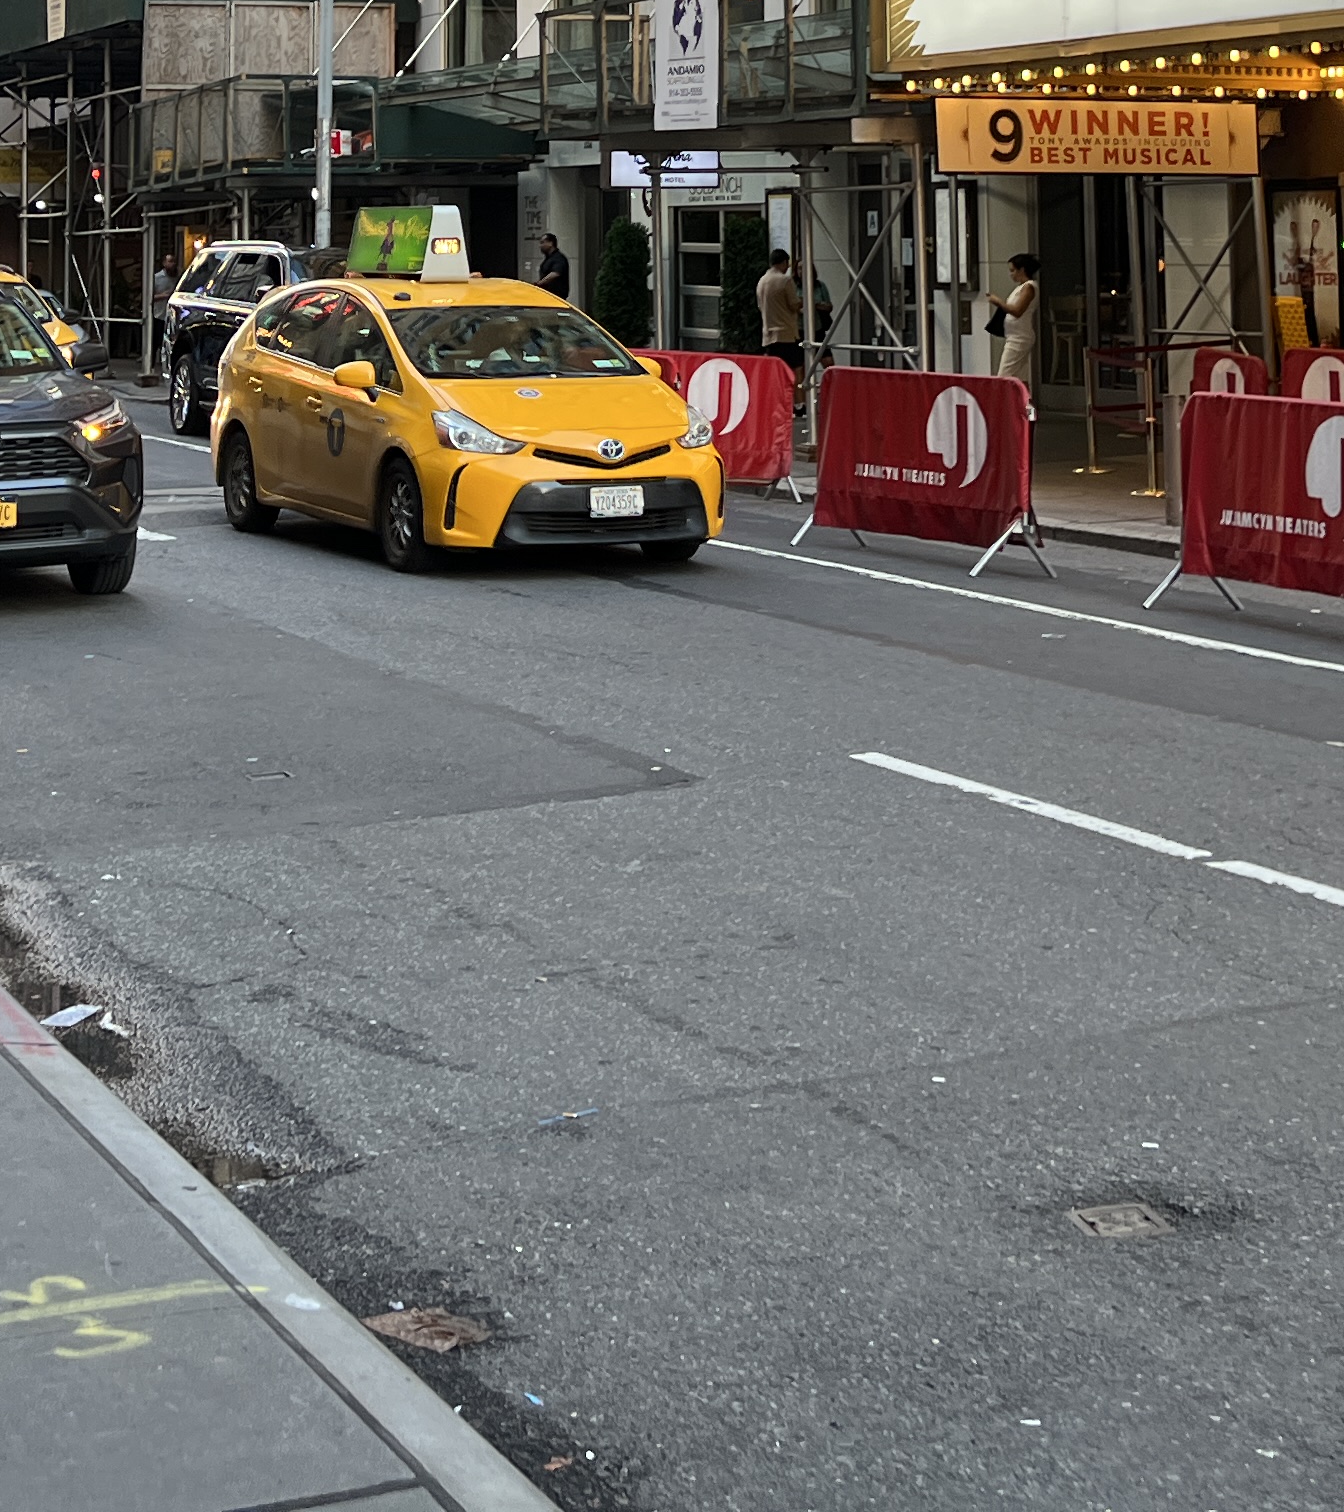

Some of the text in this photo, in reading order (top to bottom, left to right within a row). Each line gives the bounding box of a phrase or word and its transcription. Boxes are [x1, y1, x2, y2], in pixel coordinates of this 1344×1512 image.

[988, 108, 1210, 164] 9 WINNER!
[1029, 136, 1065, 146] TONY
[1138, 138, 1212, 148] INCLUDING
[1029, 147, 1212, 166] BEST MUSICAL
[901, 468, 947, 487] THEATERS
[594, 494, 638, 511] Y204359C
